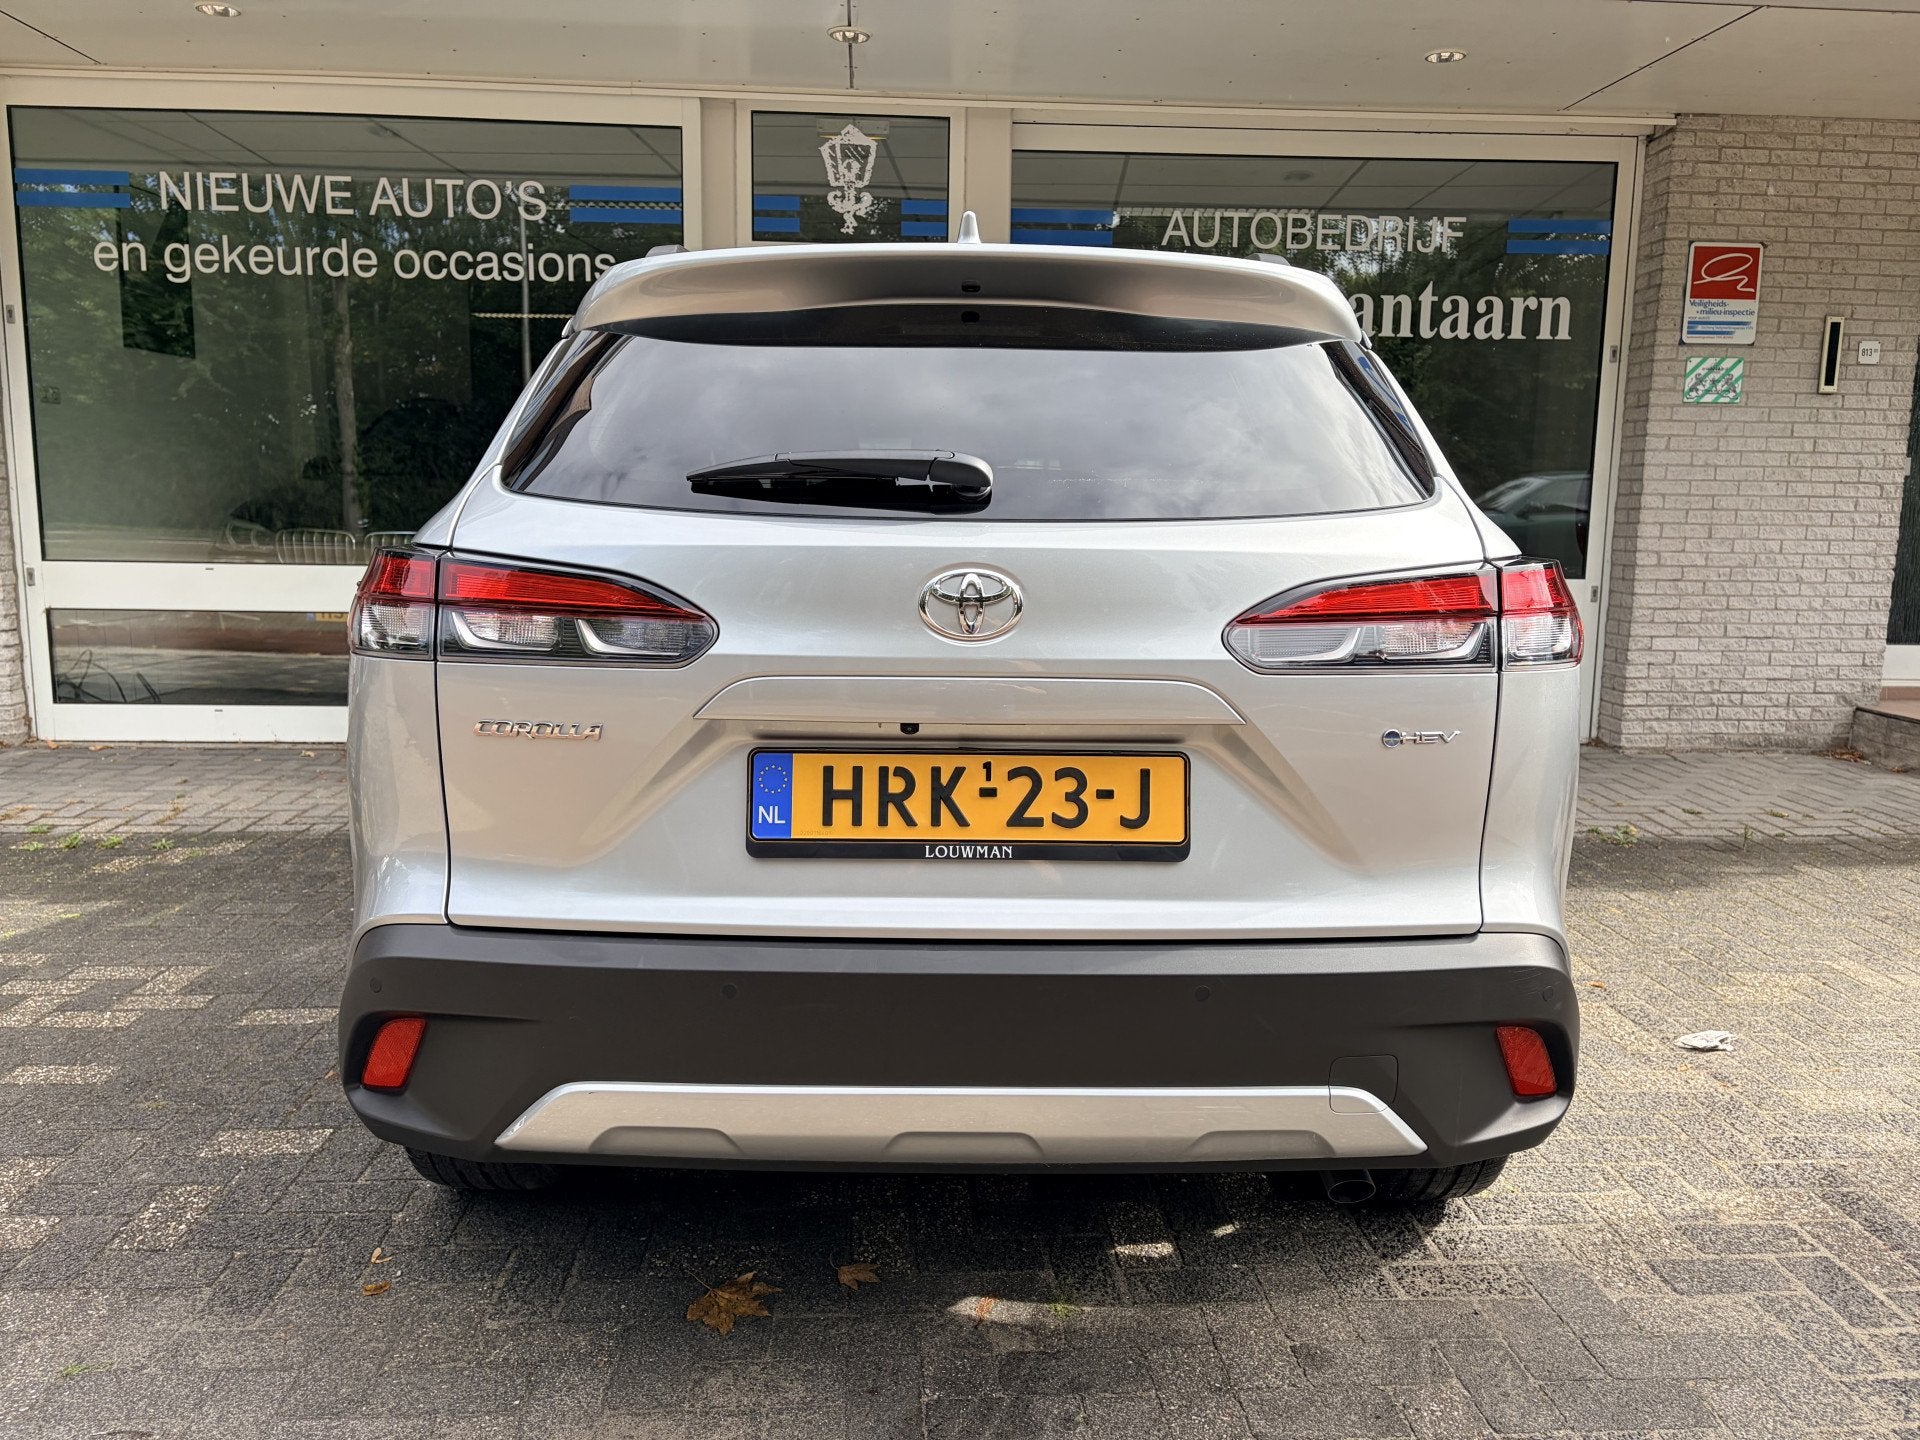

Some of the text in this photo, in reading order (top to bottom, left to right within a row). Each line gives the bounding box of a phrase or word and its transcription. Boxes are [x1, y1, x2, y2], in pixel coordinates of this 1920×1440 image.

[159, 171, 547, 222] NIEUWE AUTO'S
[1161, 210, 1467, 253] AUTOBEDRIJF
[93, 235, 616, 284] en gekeurde occasions
[473, 719, 603, 741] COROLLA
[1400, 730, 1461, 745] HEV
[758, 805, 786, 825] NL
[924, 844, 1013, 859] LOUWMAN
